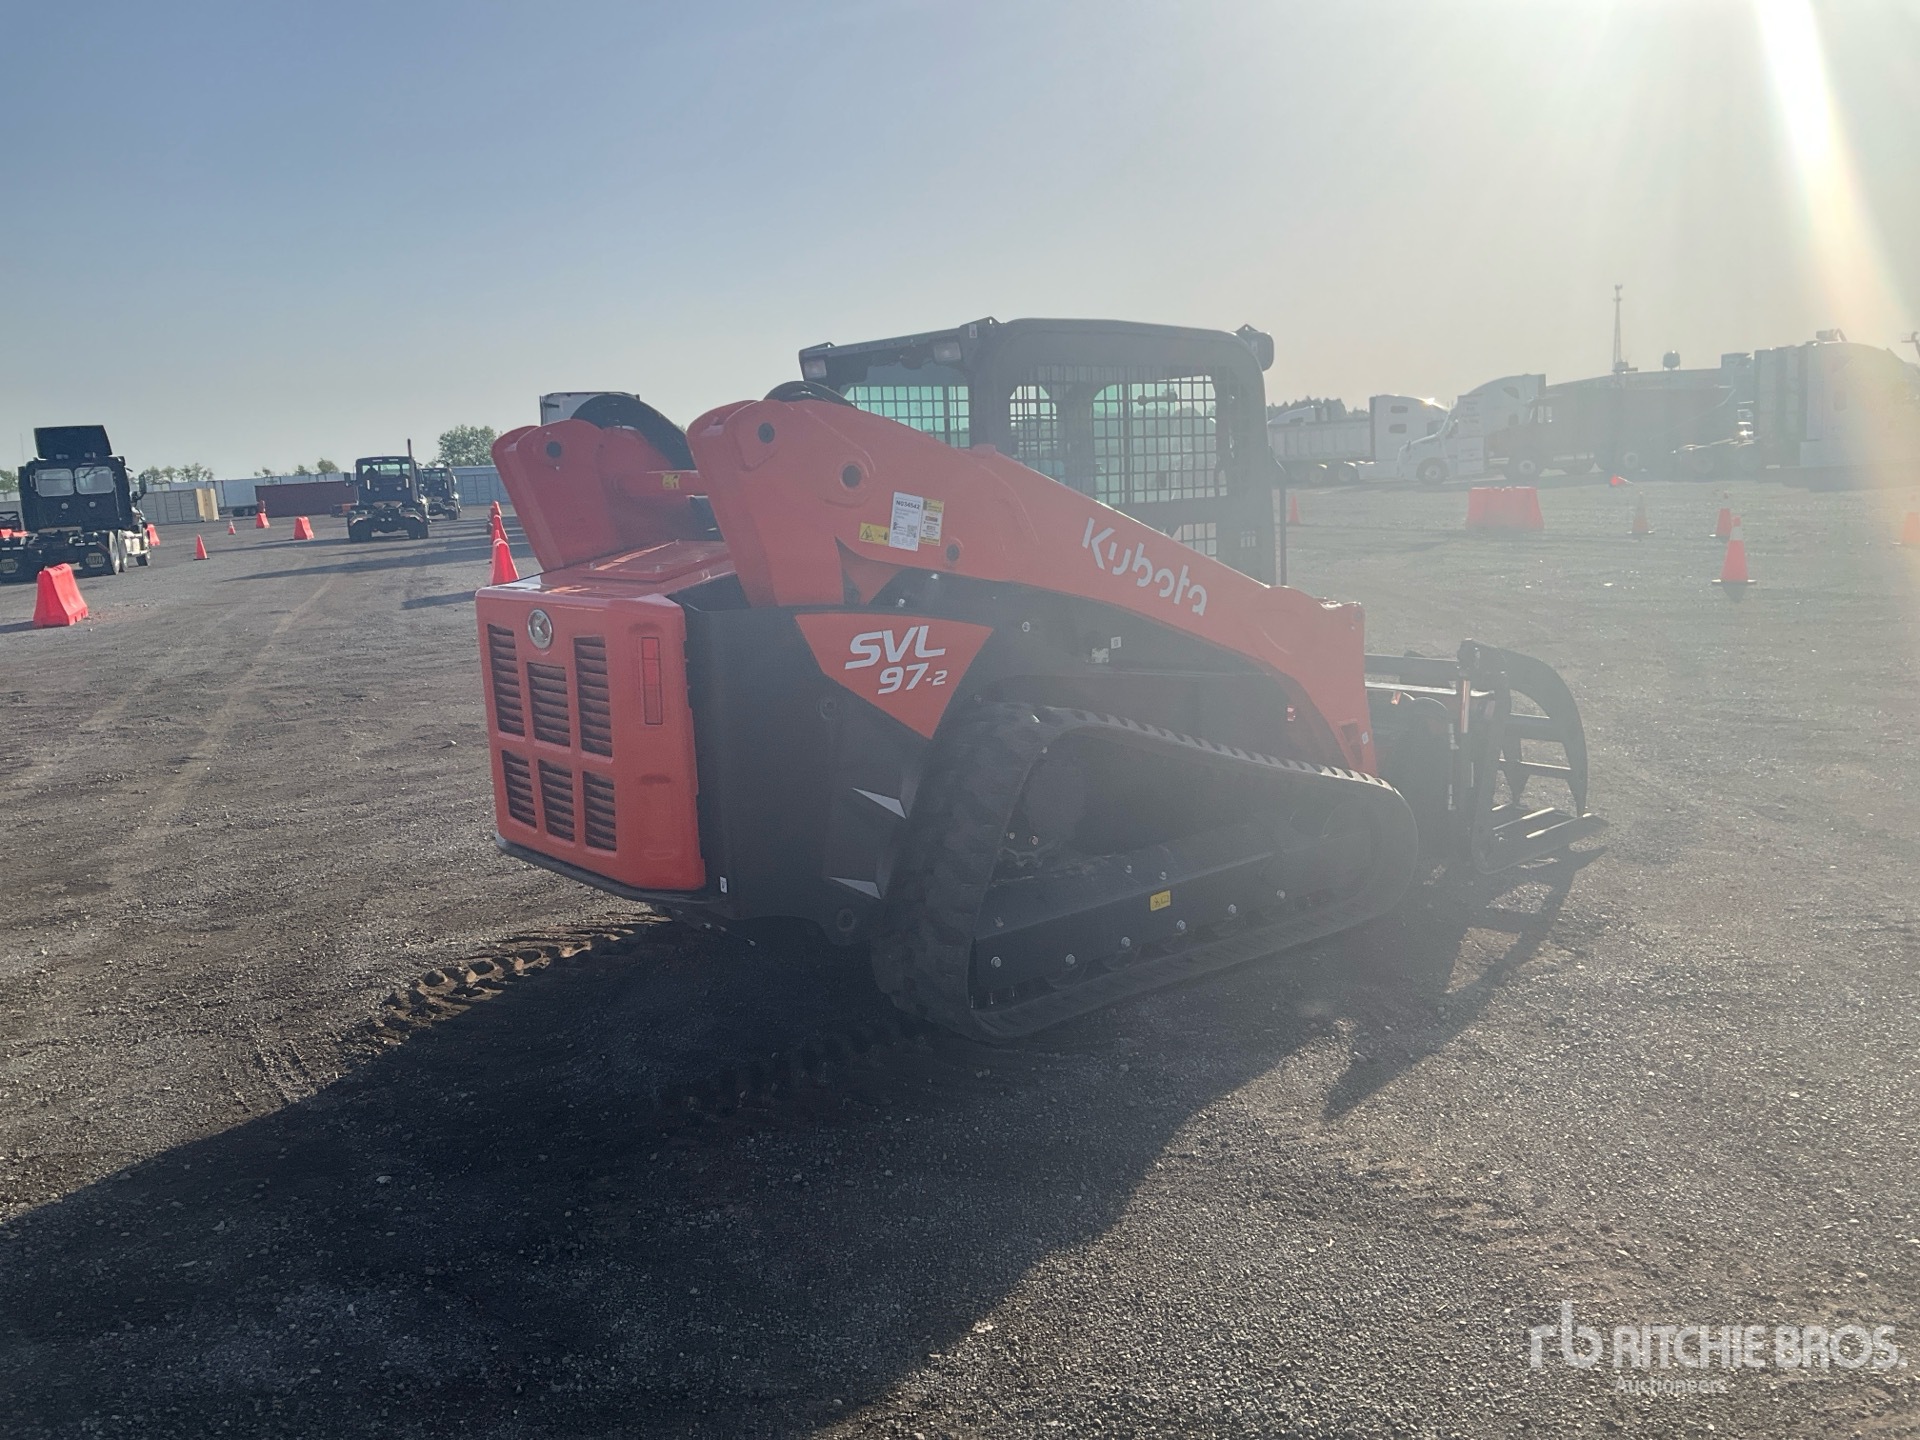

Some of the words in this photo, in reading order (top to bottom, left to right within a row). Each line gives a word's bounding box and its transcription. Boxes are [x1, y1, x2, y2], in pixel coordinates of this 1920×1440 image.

[1082, 517, 1207, 616] Kubota
[844, 625, 947, 670] SVL
[877, 662, 948, 695] 97-2
